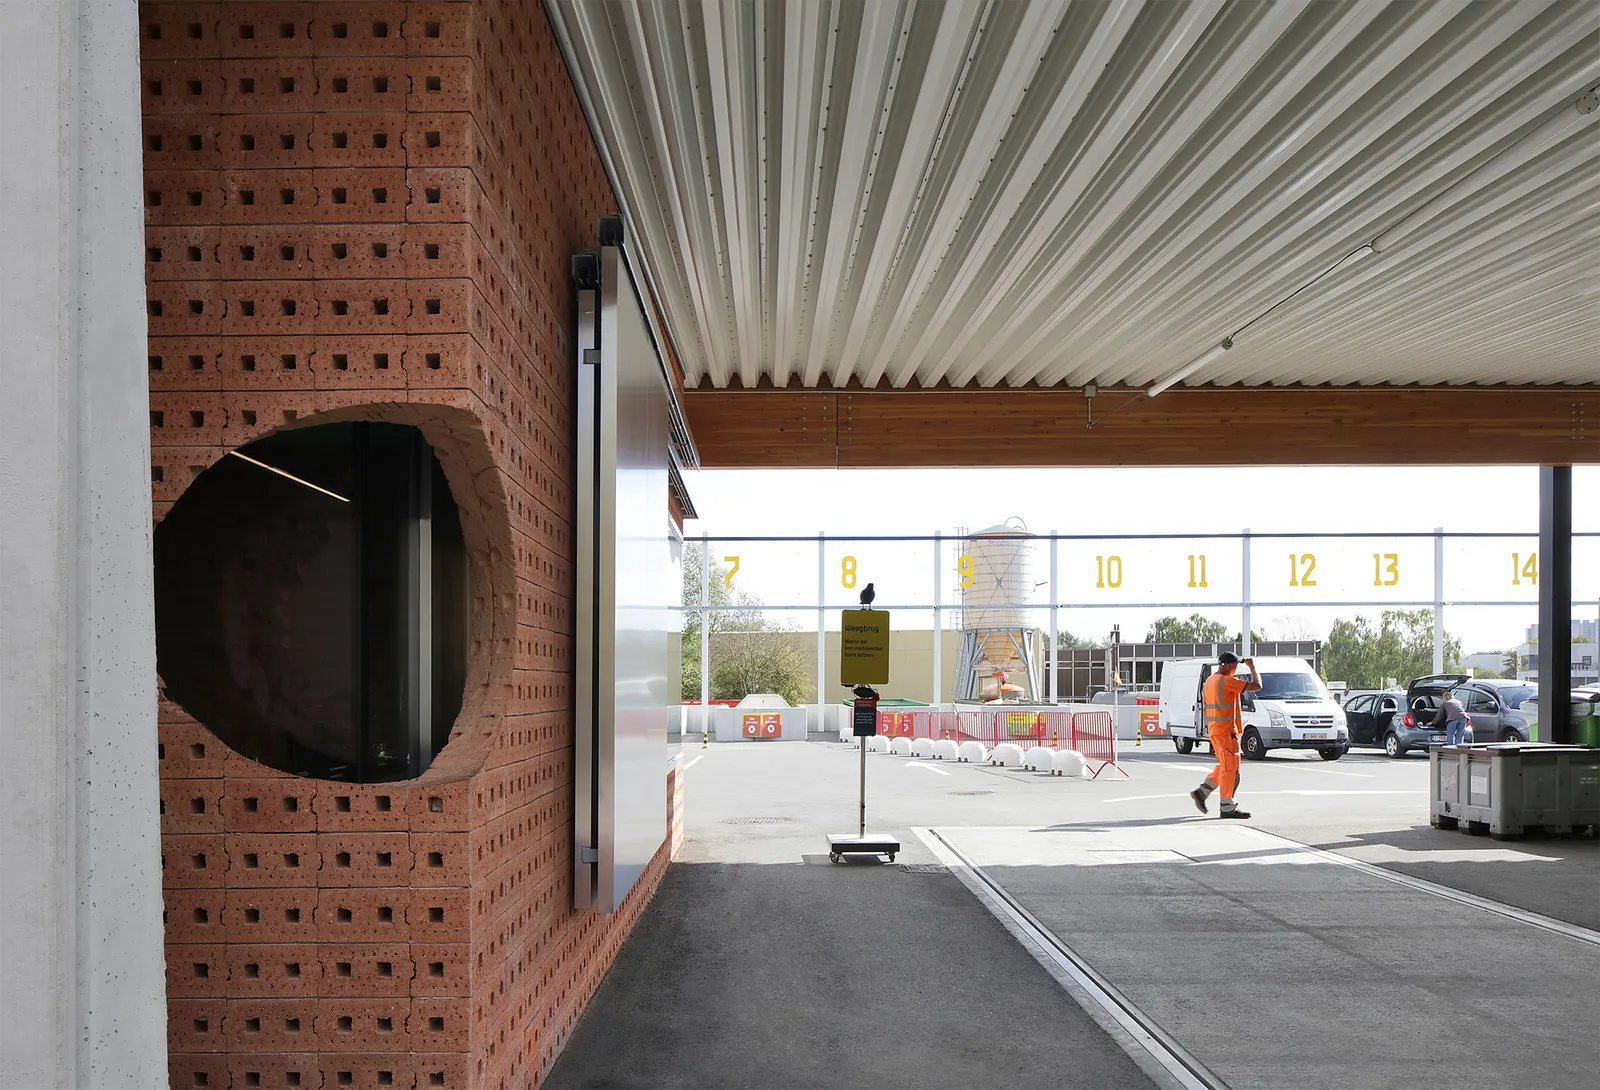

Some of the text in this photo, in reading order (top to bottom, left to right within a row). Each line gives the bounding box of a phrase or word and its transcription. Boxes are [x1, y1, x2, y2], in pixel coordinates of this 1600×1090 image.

[724, 556, 739, 589] 7
[841, 555, 857, 589] 8
[957, 554, 974, 588] 9
[1096, 555, 1122, 588] 10
[1188, 555, 1208, 588] 11
[1289, 554, 1317, 586] 12
[1373, 553, 1399, 586] 13
[1512, 553, 1537, 585] 14
[844, 625, 879, 633] Weegbrug
